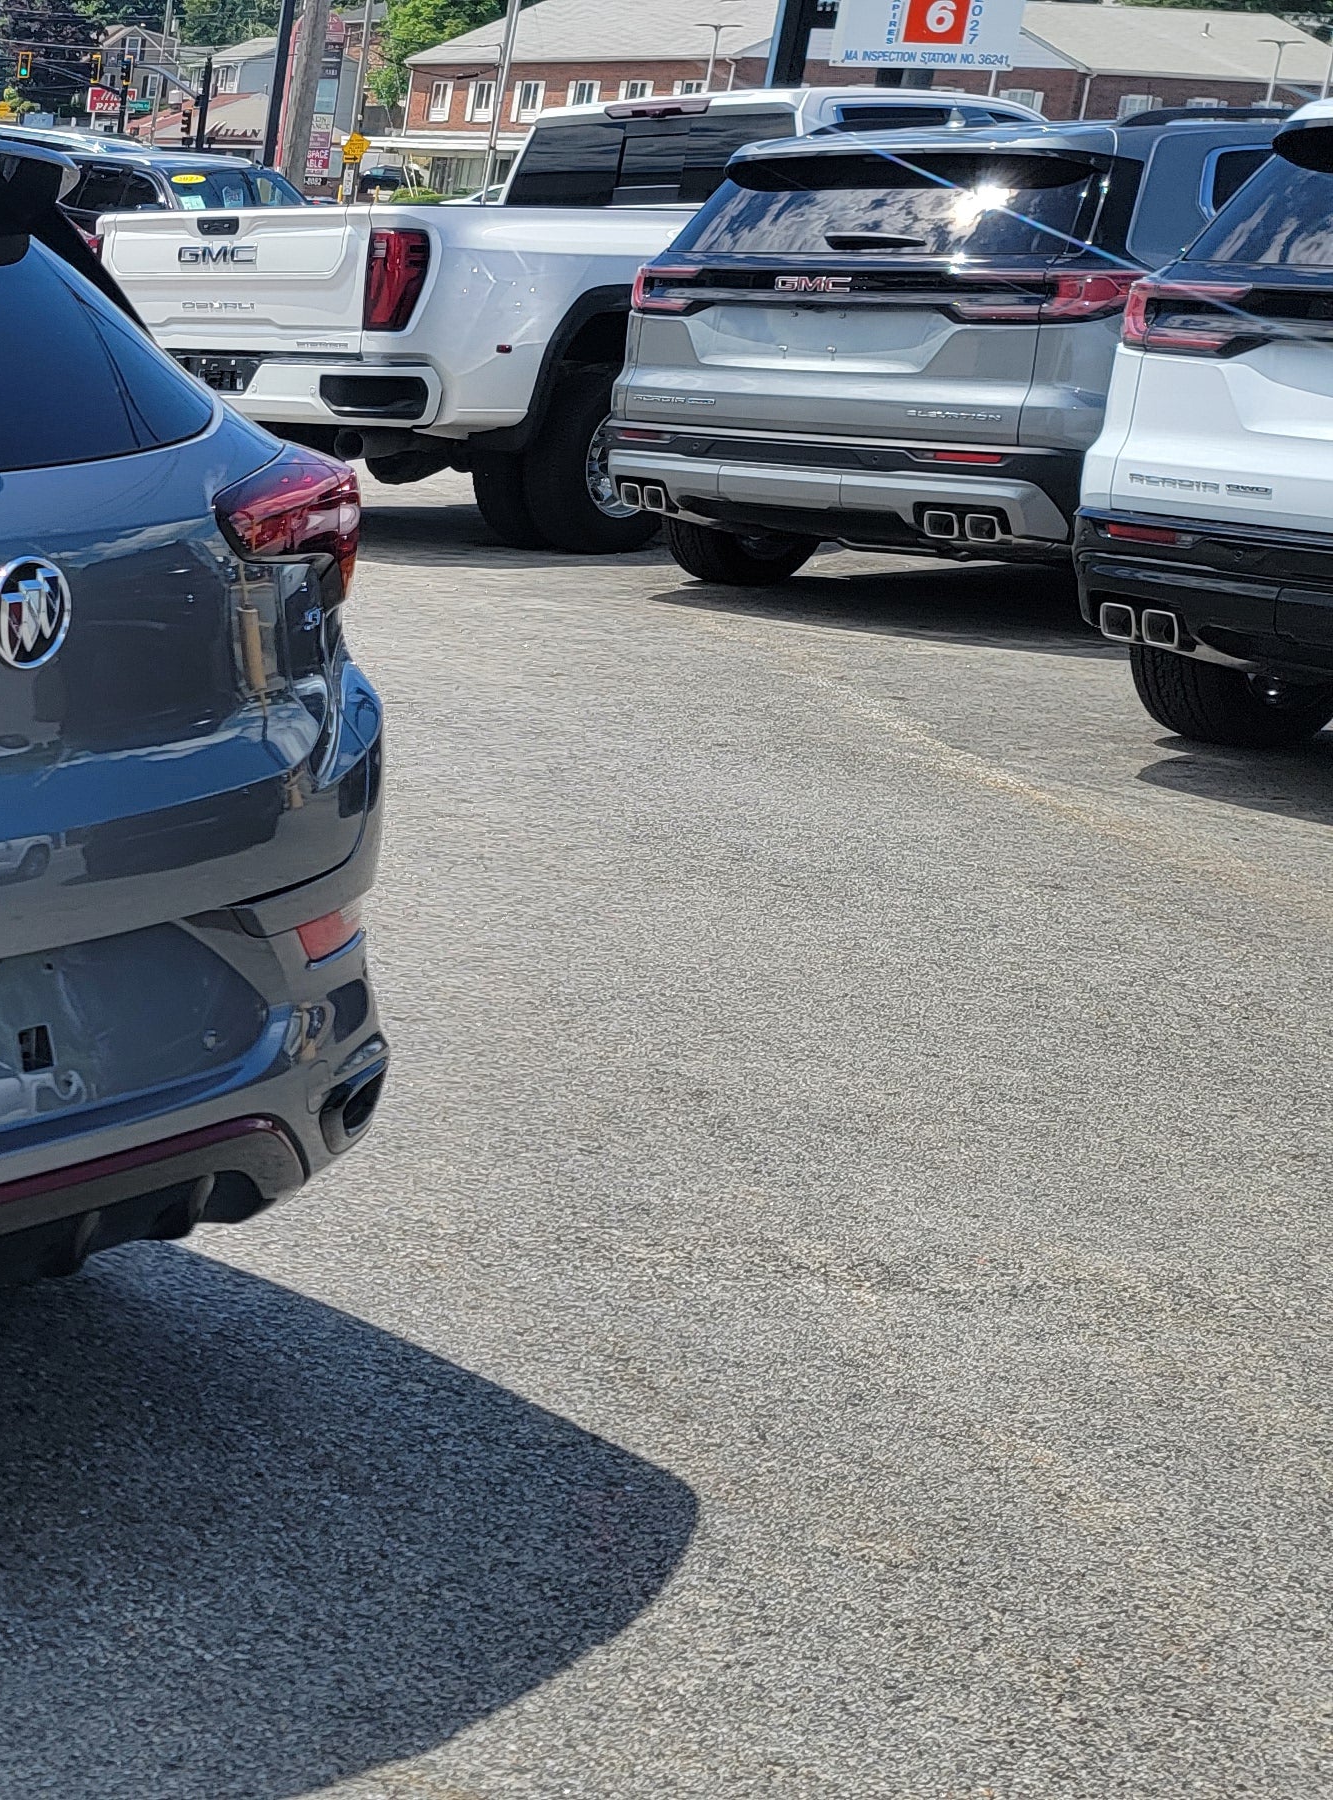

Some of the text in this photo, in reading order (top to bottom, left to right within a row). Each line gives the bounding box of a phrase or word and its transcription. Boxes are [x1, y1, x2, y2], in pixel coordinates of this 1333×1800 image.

[885, 0, 901, 44] PIRES
[926, 0, 957, 33] 6
[968, 0, 984, 44] 027
[844, 50, 1010, 66] MA INSPECTION STATION NO. 36241
[95, 102, 121, 111] PIZZ
[178, 245, 258, 264] GMC
[774, 276, 852, 292] GMC
